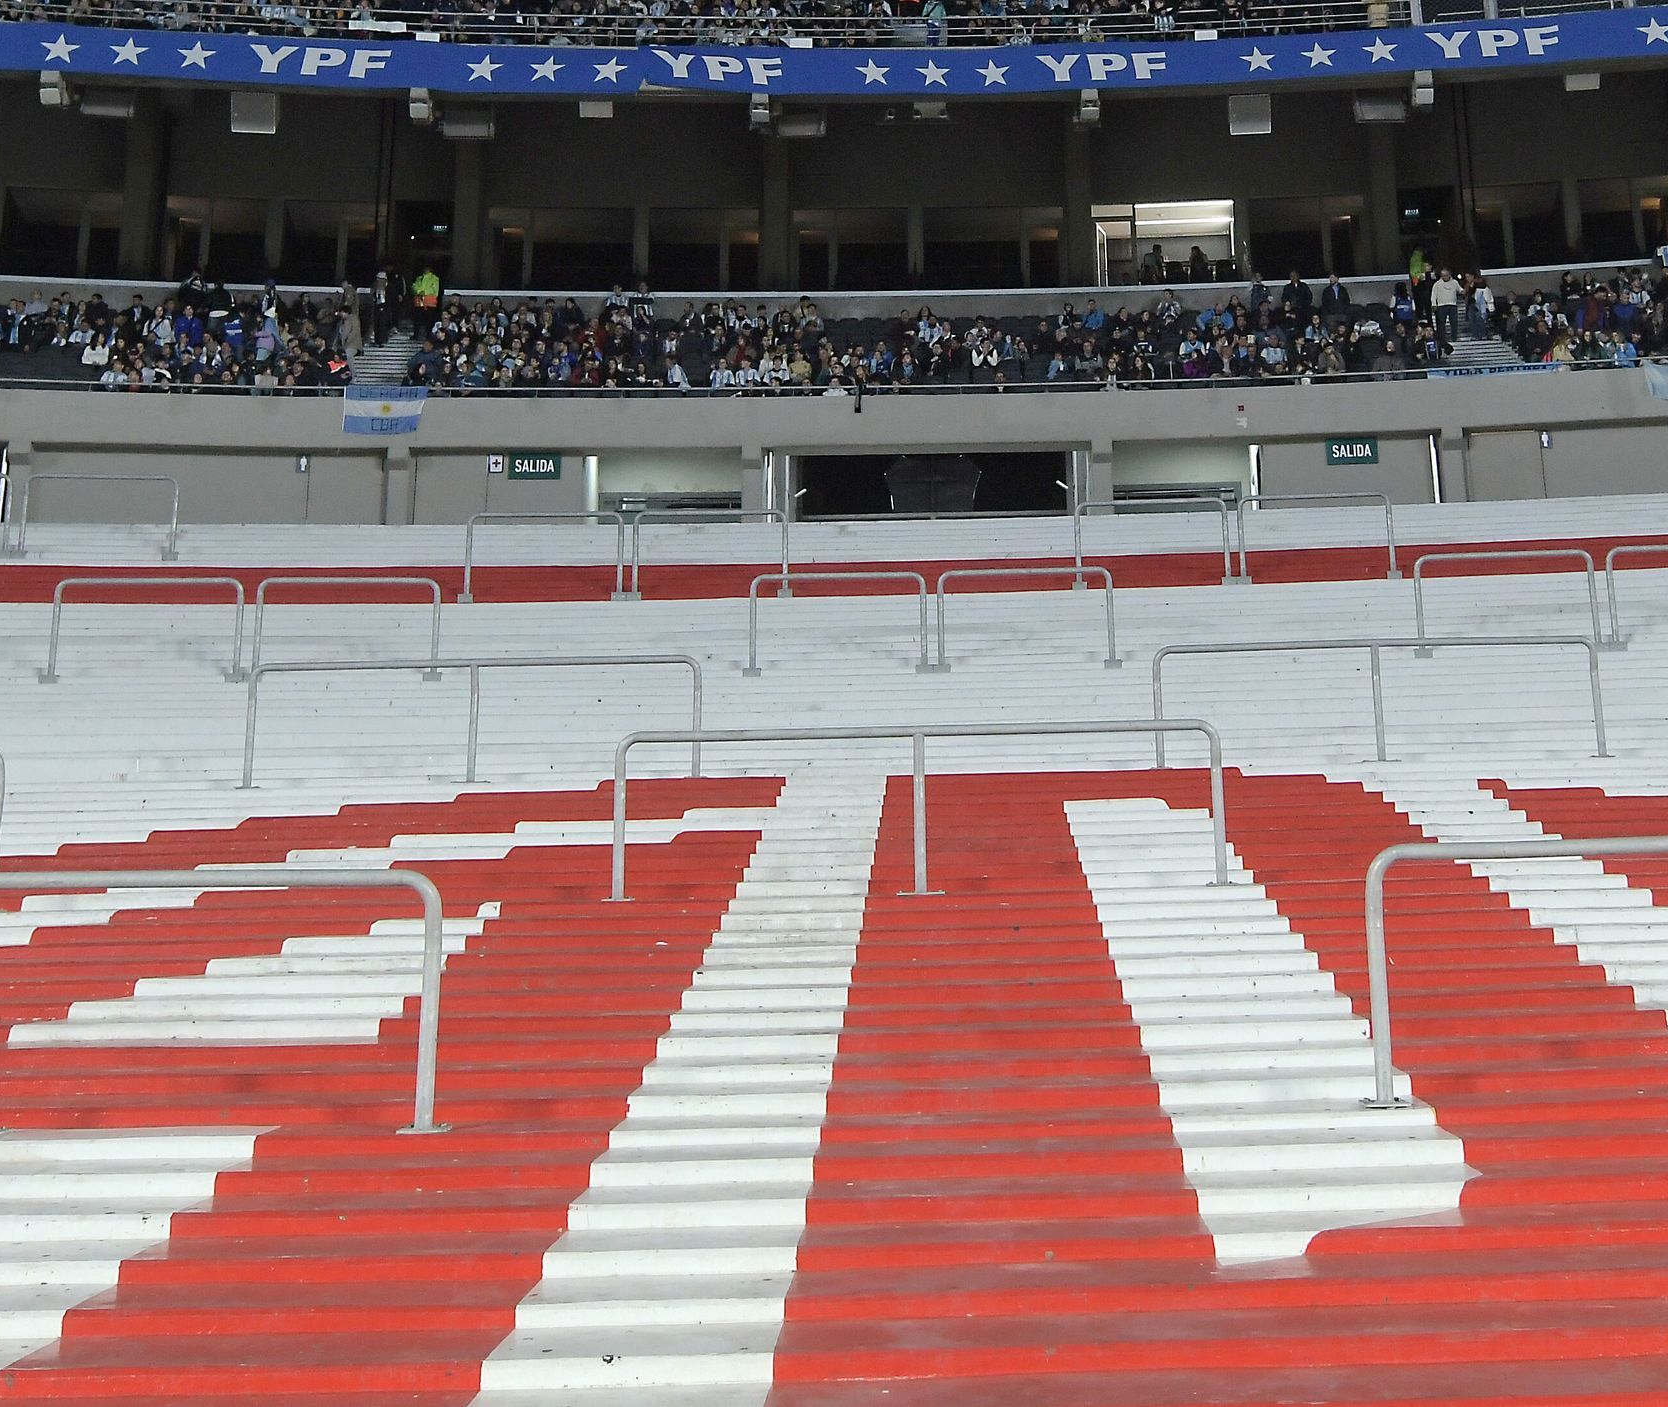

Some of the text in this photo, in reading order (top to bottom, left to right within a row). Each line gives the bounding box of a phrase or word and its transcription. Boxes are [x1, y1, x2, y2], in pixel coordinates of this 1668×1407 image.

[1422, 24, 1560, 59] YPF
[248, 43, 394, 79] YPF
[650, 49, 784, 86] YPF
[1034, 51, 1168, 82] YPF
[514, 458, 555, 473] SALIDA
[1332, 443, 1372, 458] SALIDA
